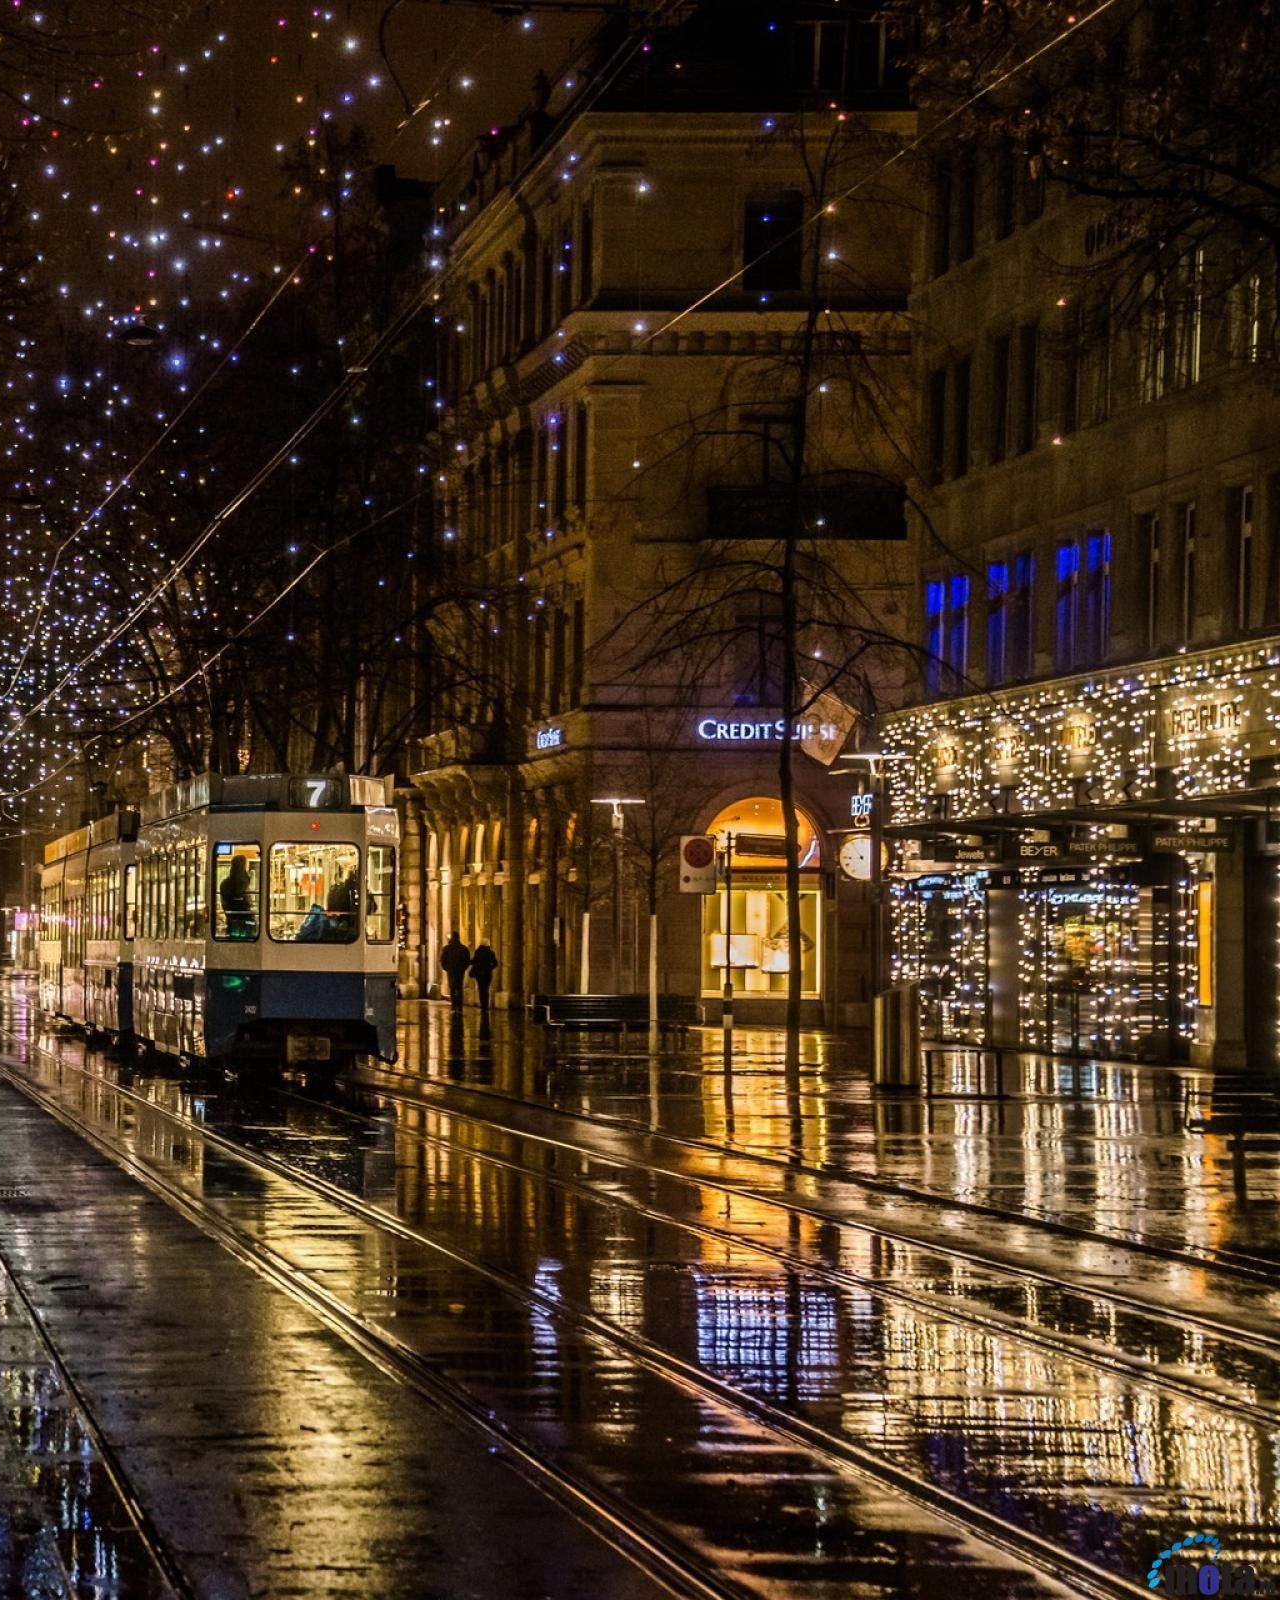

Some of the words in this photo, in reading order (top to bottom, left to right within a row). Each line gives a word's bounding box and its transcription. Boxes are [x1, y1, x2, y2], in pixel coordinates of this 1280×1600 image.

[698, 719, 772, 741] CREDIT
[306, 780, 327, 808] 7
[1155, 837, 1186, 847] PATEK
[1187, 837, 1230, 849] PHILIPPE
[954, 849, 985, 860] Jewels
[1019, 845, 1058, 857] BEYER
